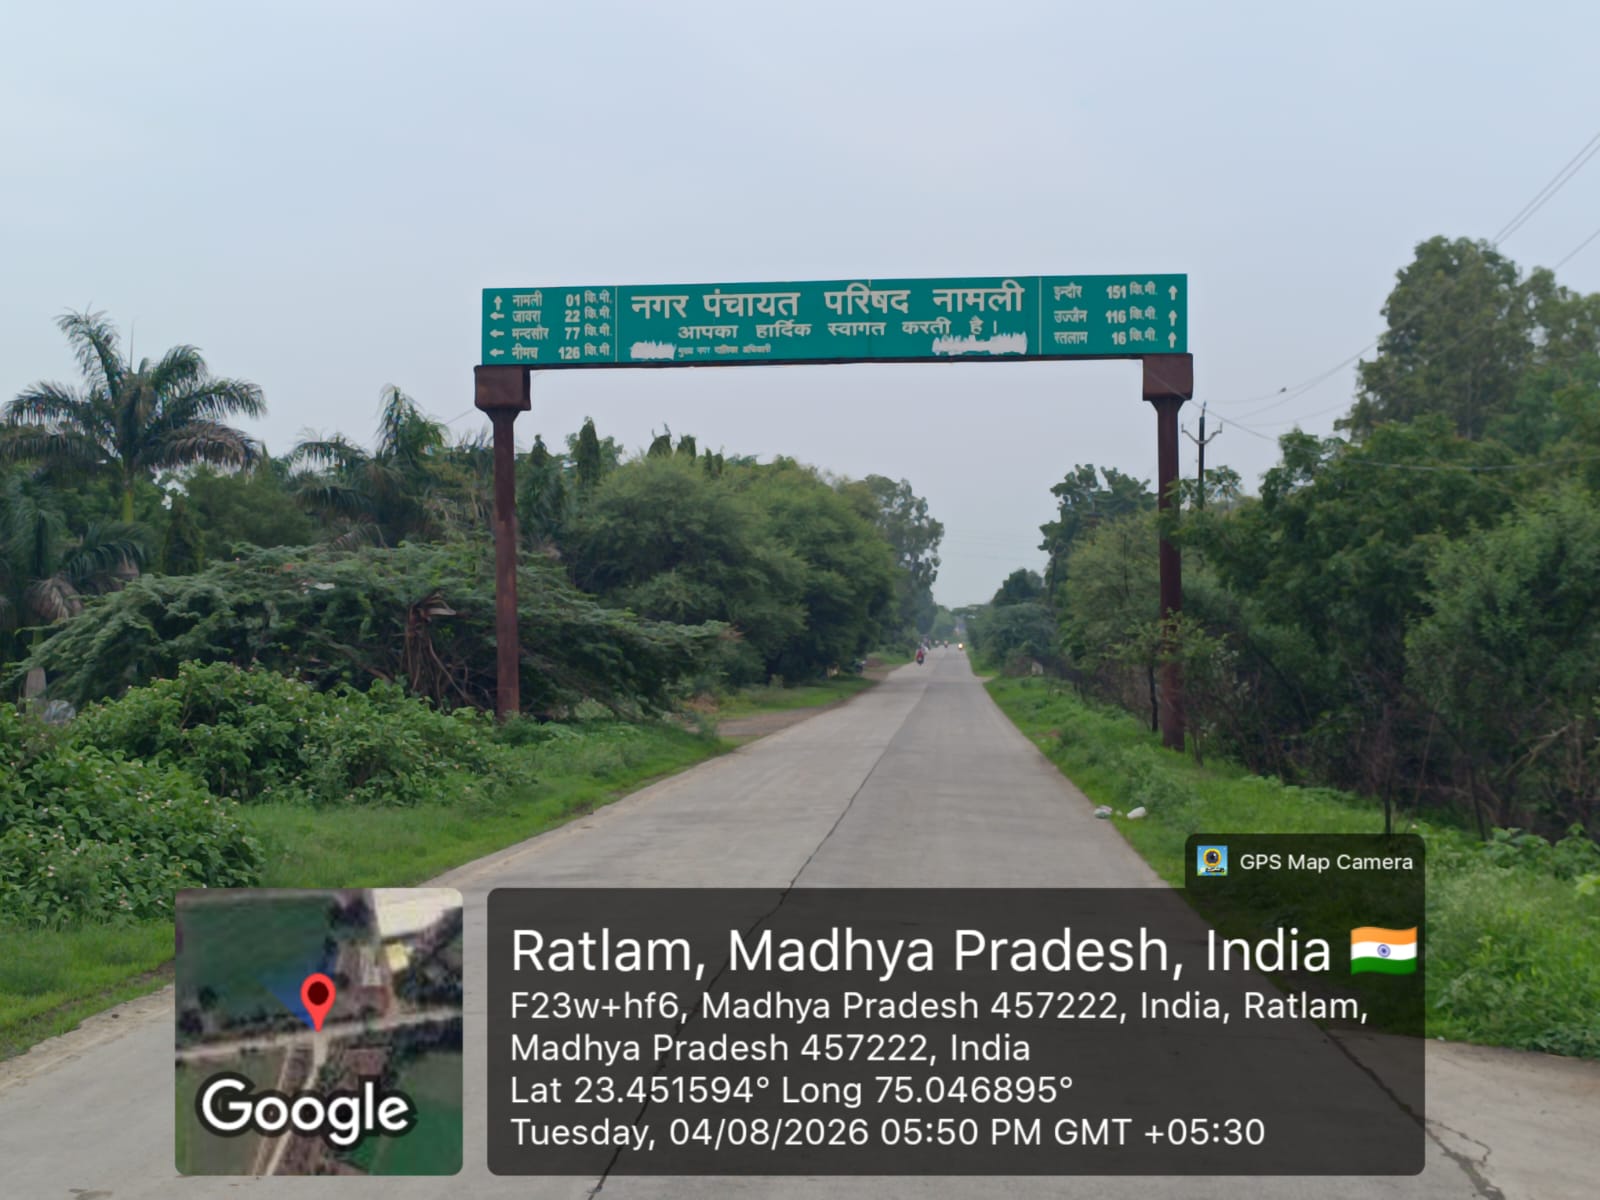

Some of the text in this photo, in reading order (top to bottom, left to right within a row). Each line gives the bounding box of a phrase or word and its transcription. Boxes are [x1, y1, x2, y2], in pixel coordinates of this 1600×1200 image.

[512, 289, 543, 307] नामली
[565, 294, 581, 307] 01
[630, 278, 1025, 320] नगर पंचायत परिषद नामली
[1106, 285, 1127, 299] 151
[512, 309, 542, 323] जावरा
[564, 309, 581, 323] 22
[1105, 309, 1127, 324] 116
[564, 327, 581, 340] 77
[678, 324, 739, 339] आपका
[755, 319, 812, 338] हार्दिक
[827, 321, 887, 336] स्वागत
[901, 316, 952, 335] करती
[1111, 331, 1127, 345] 16
[511, 342, 539, 360] नीमच
[558, 346, 581, 360] 126
